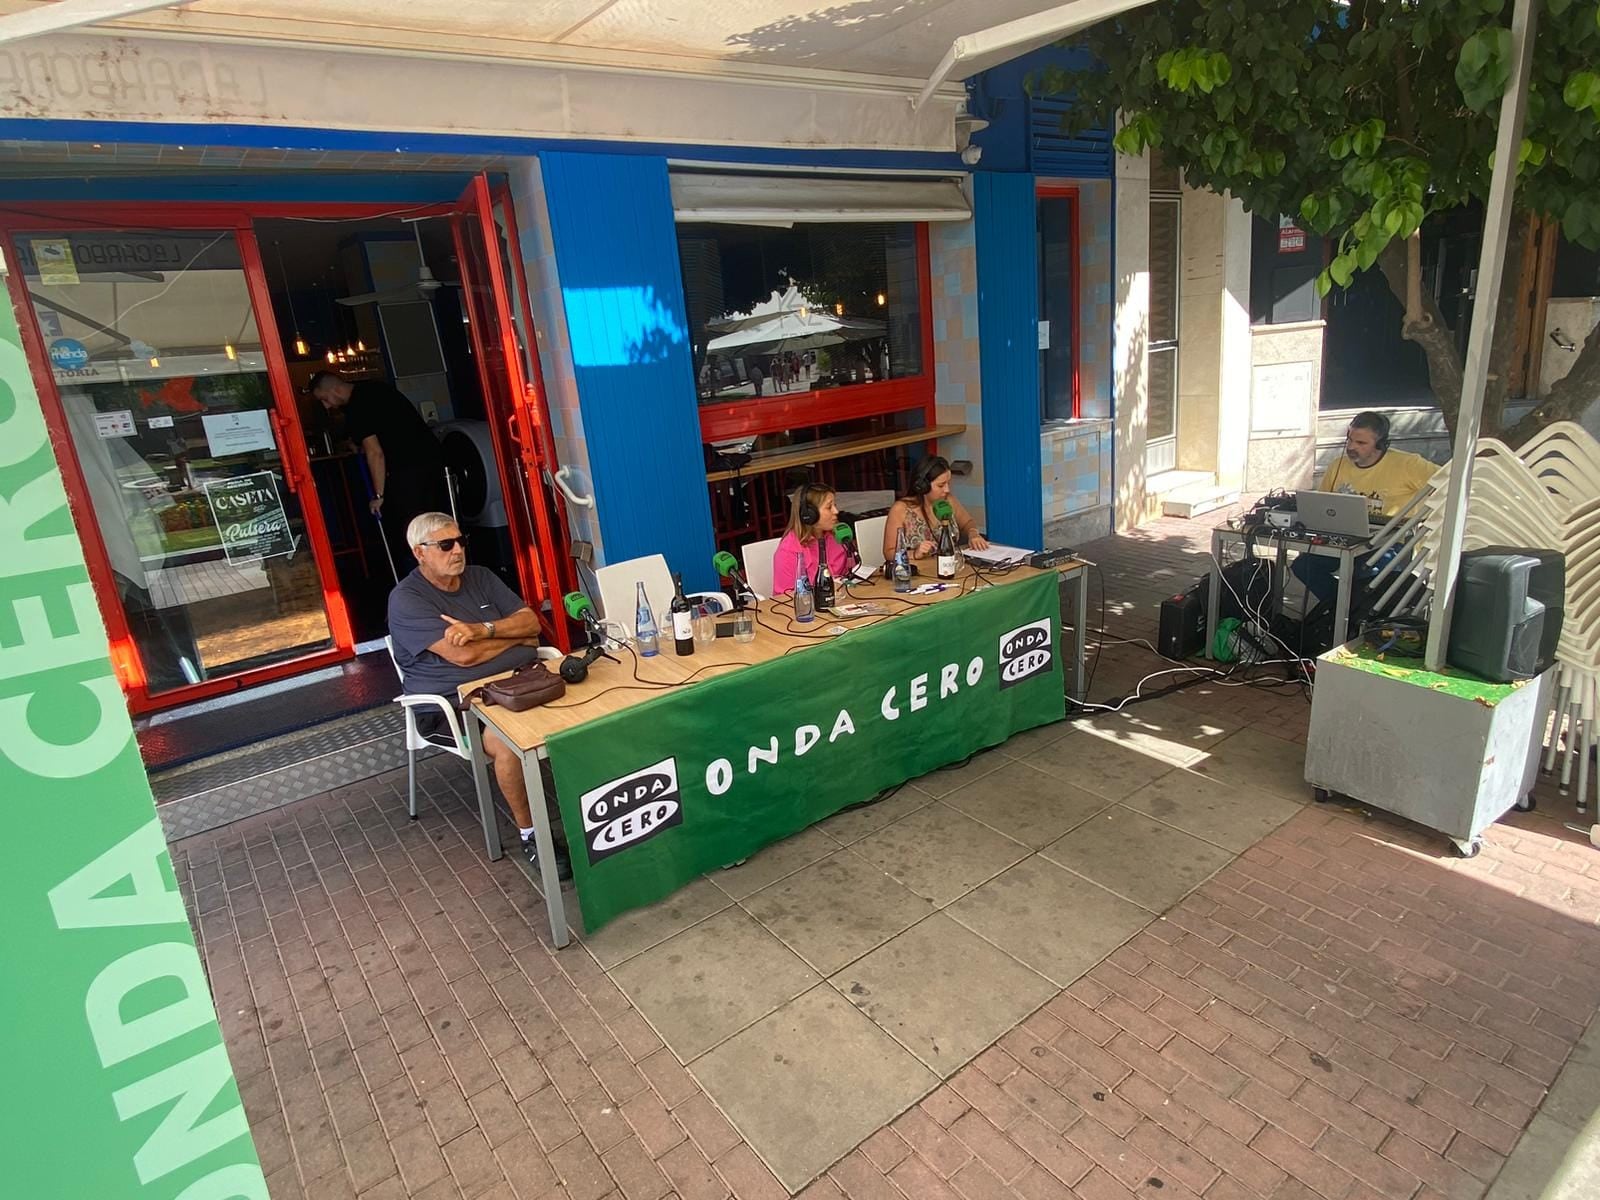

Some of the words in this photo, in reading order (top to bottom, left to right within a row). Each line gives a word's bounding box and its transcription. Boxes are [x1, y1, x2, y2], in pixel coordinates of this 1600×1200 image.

[215, 488, 275, 510] CASETA
[225, 520, 282, 542] Pulsera
[1006, 631, 1044, 655] ONDA
[1009, 653, 1044, 676] CERO
[705, 709, 856, 796] ONDA
[881, 656, 984, 721] CERO
[595, 778, 665, 817] ONDA
[604, 805, 667, 843] CERO
[48, 816, 271, 1200] NDA
